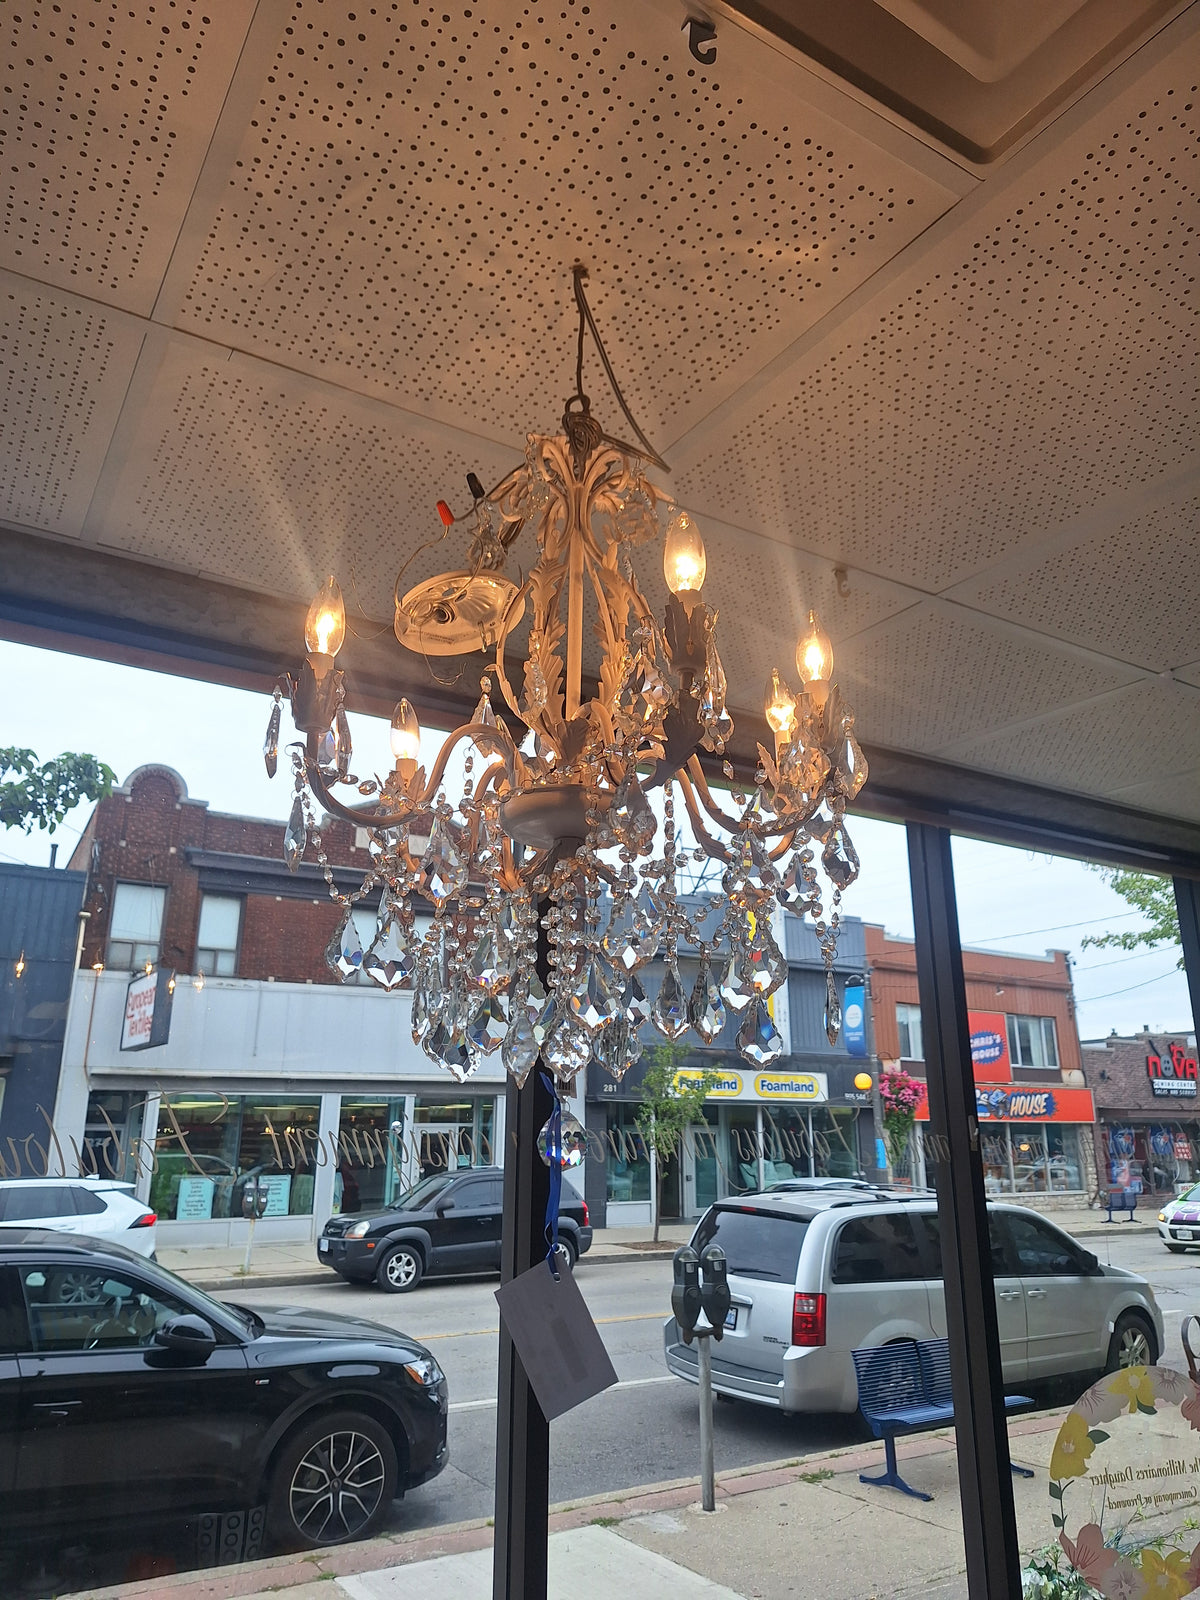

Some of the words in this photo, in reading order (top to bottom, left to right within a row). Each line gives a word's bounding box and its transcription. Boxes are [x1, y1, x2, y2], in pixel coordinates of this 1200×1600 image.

[971, 1047, 1000, 1061] HOUSE
[603, 1084, 617, 1092] 281
[679, 1076, 738, 1091] Foaland
[760, 1079, 814, 1093] Foamland
[1009, 1093, 1049, 1116] HOUSE
